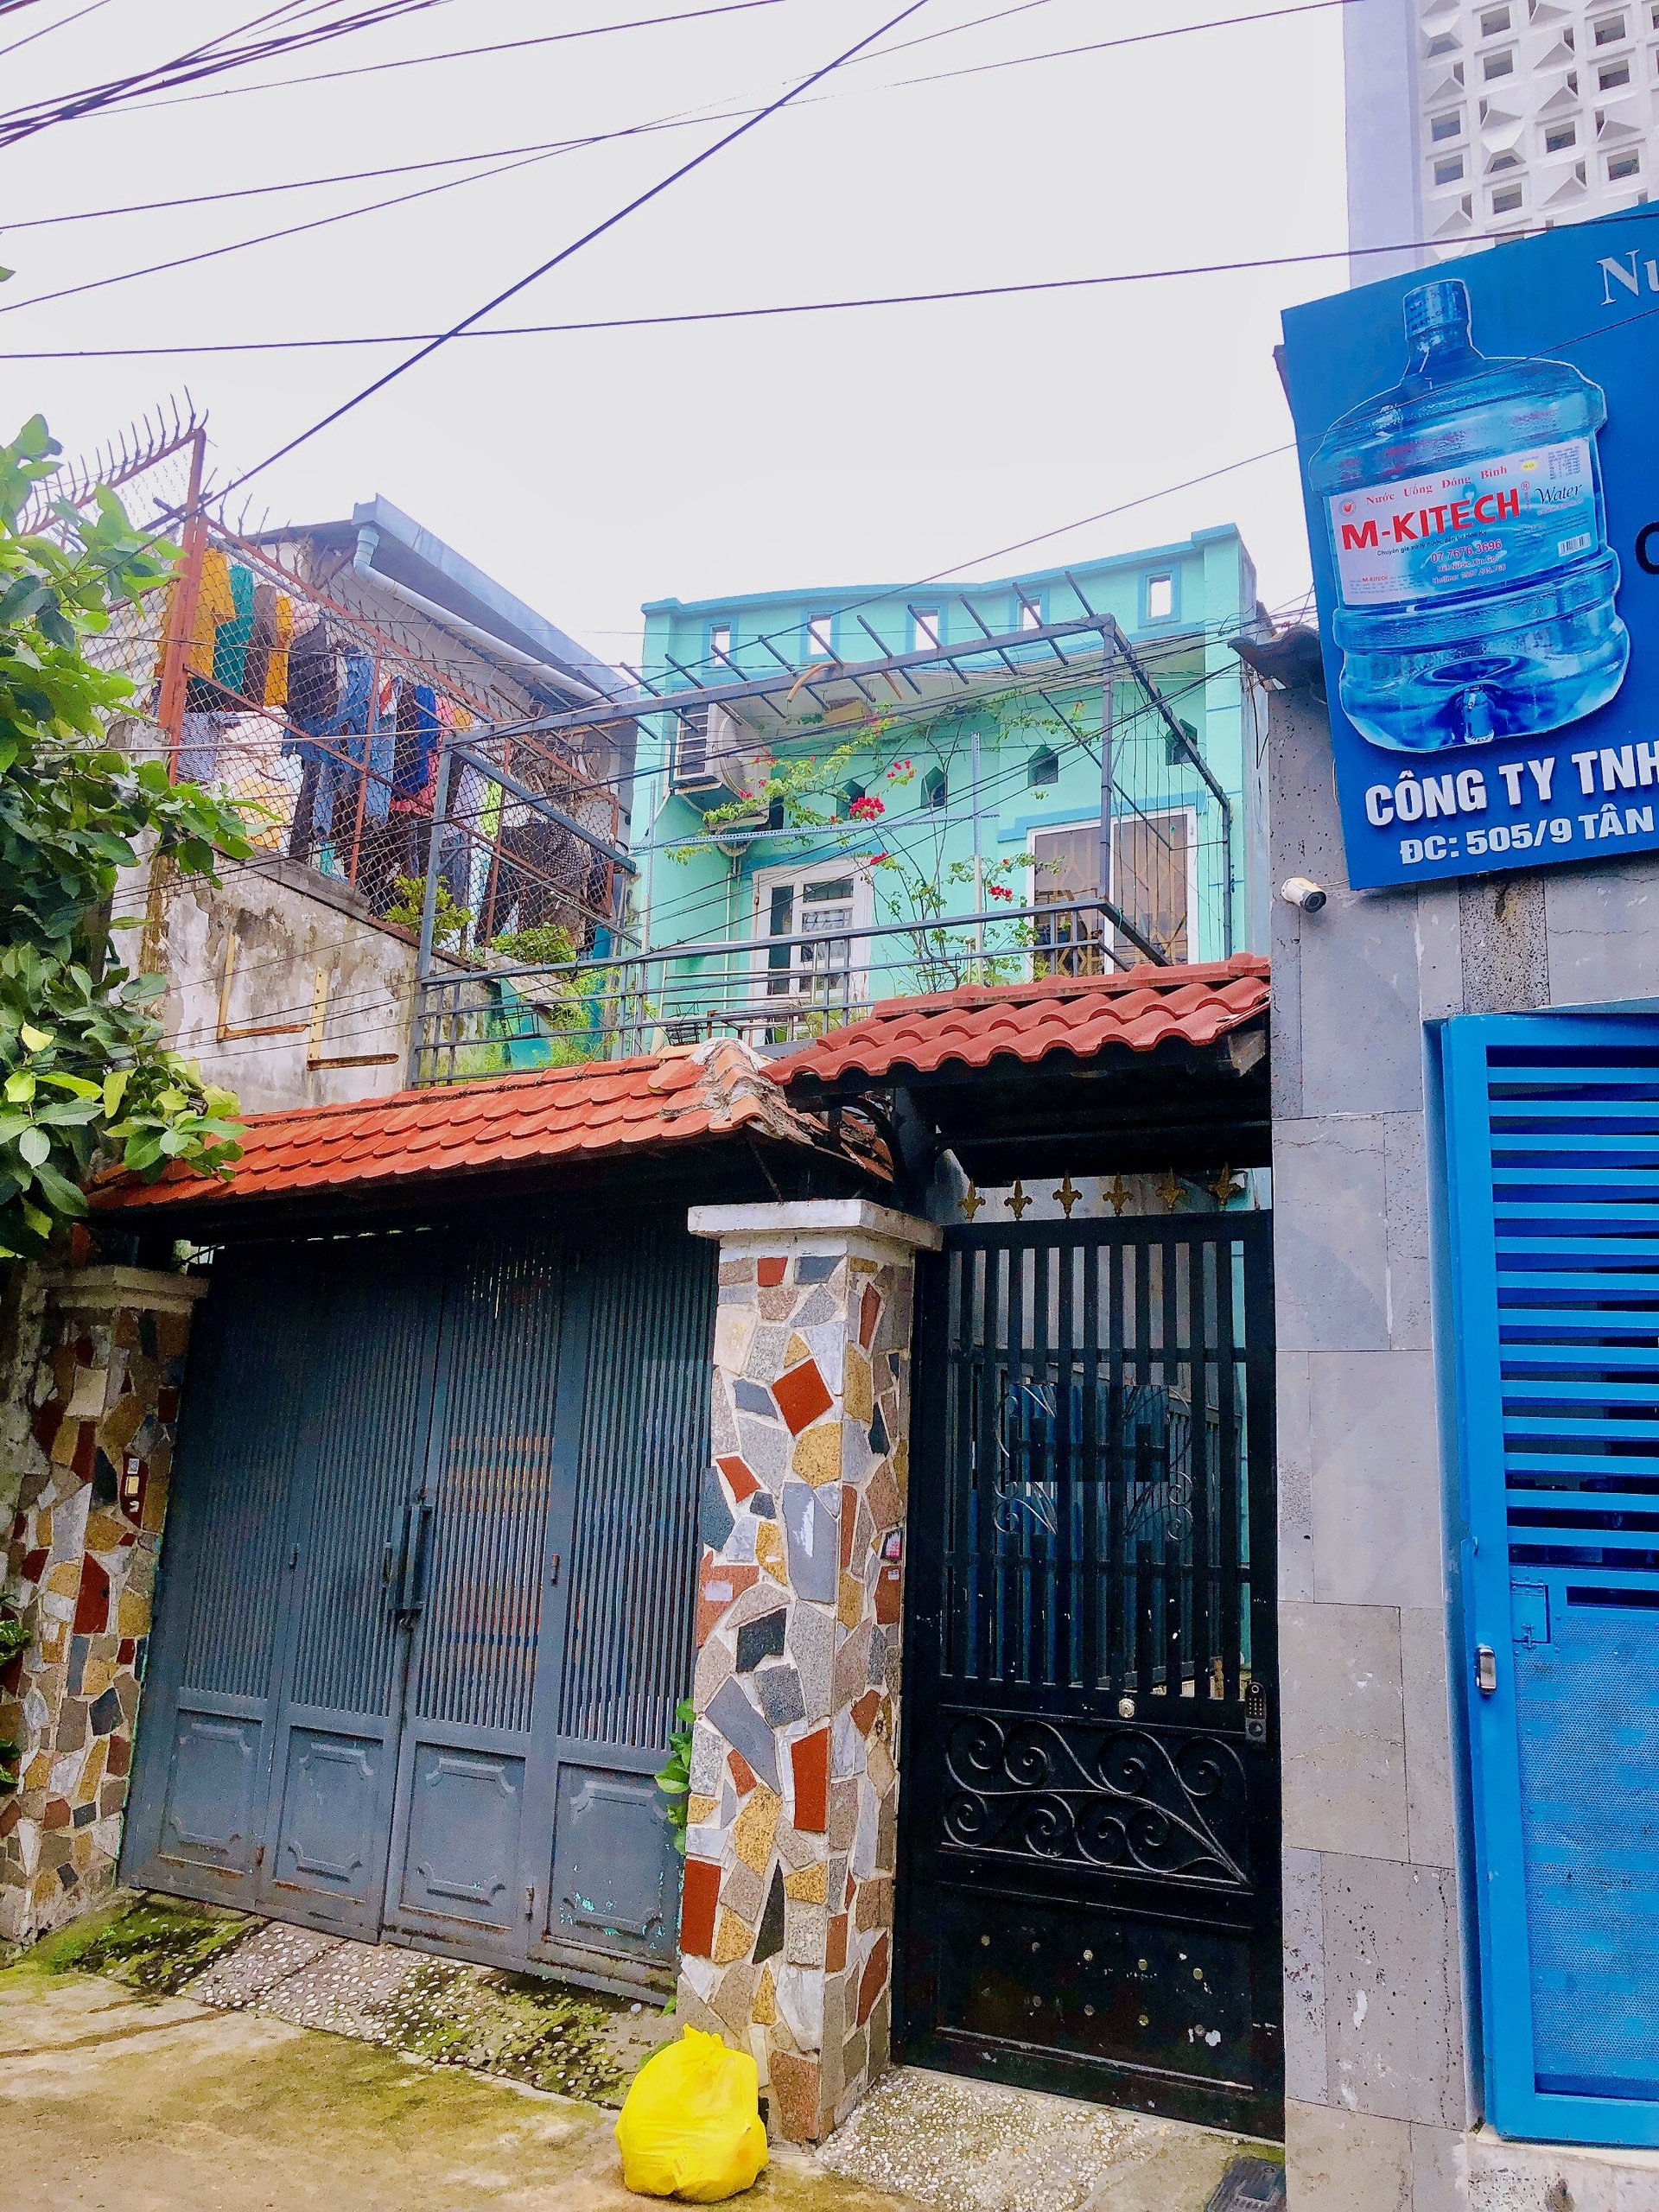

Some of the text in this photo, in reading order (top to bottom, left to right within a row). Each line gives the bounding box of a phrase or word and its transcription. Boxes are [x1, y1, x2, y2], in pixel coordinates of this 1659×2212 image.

[1366, 466, 1507, 505] Nước Uống Đóng Bình
[1534, 484, 1582, 504] Water
[1341, 488, 1520, 550] M-KITECH
[1431, 539, 1503, 563] 07.7676.3696
[1365, 740, 1659, 826] CÔNG TY TNH
[1400, 803, 1655, 865] ĐC: 505/9 TÂN
